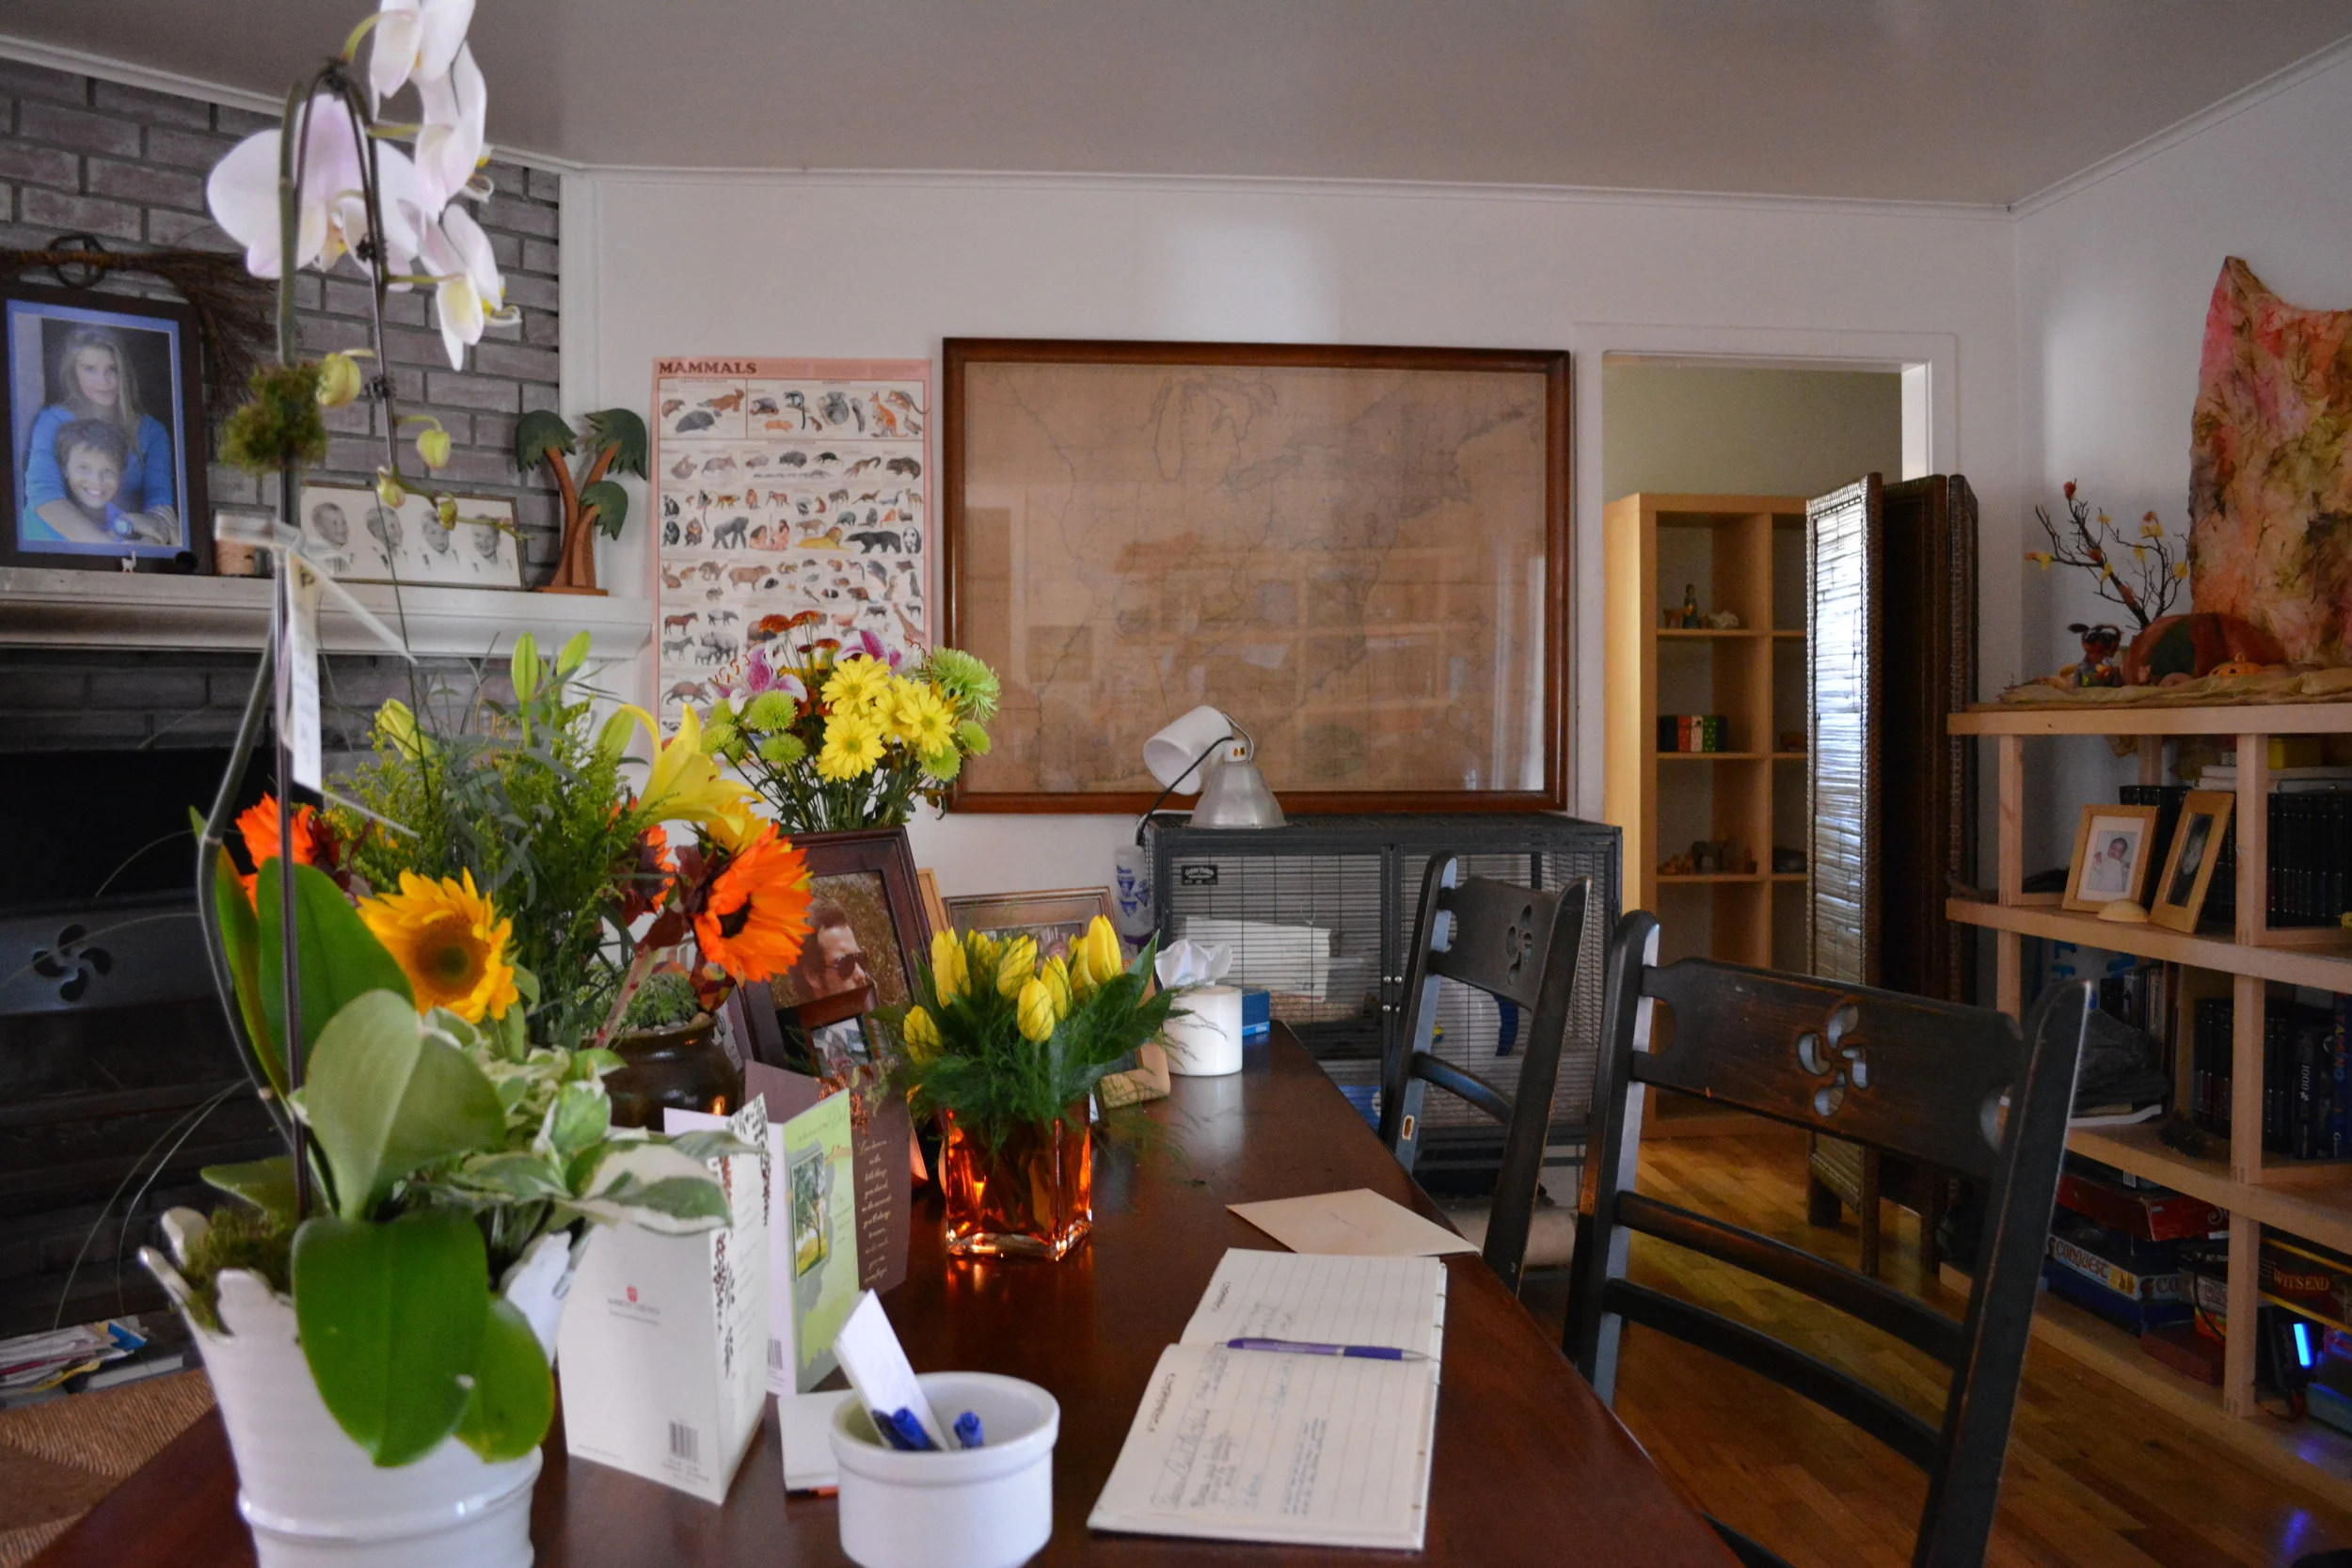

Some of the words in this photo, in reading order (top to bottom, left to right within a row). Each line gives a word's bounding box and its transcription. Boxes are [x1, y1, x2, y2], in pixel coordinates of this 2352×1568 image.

[659, 362, 757, 374] MAMMALS
[2300, 1064, 2311, 1091] 1000
[2305, 1276, 2329, 1291] END
